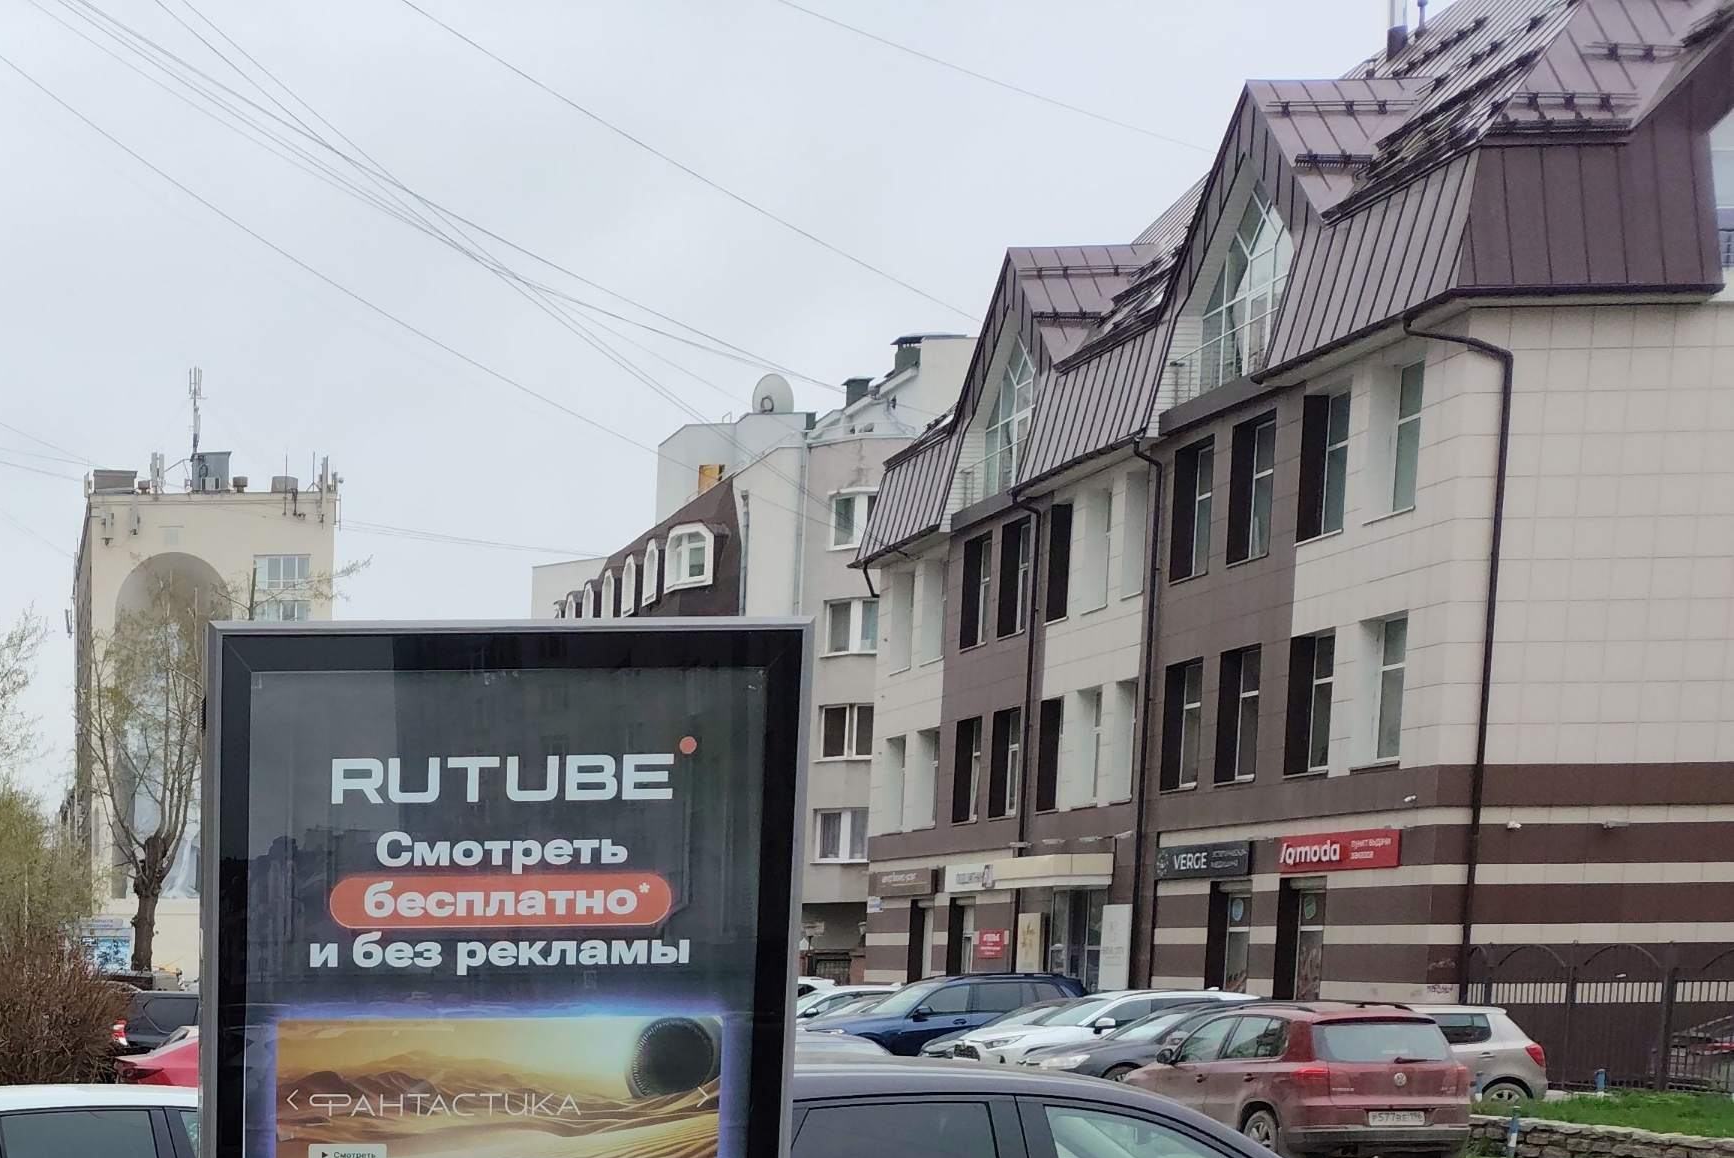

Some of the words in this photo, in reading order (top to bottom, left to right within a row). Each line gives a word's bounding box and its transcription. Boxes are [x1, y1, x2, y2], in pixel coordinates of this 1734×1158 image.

[331, 753, 675, 804] RUTUBE
[376, 830, 628, 875] Смотреть
[1173, 852, 1208, 870] VERGE
[1279, 839, 1341, 865] lamoda
[309, 942, 339, 967] и
[352, 931, 442, 968] без
[456, 938, 690, 976] рекламы
[309, 1093, 582, 1117] ФАНТАСТИКА
